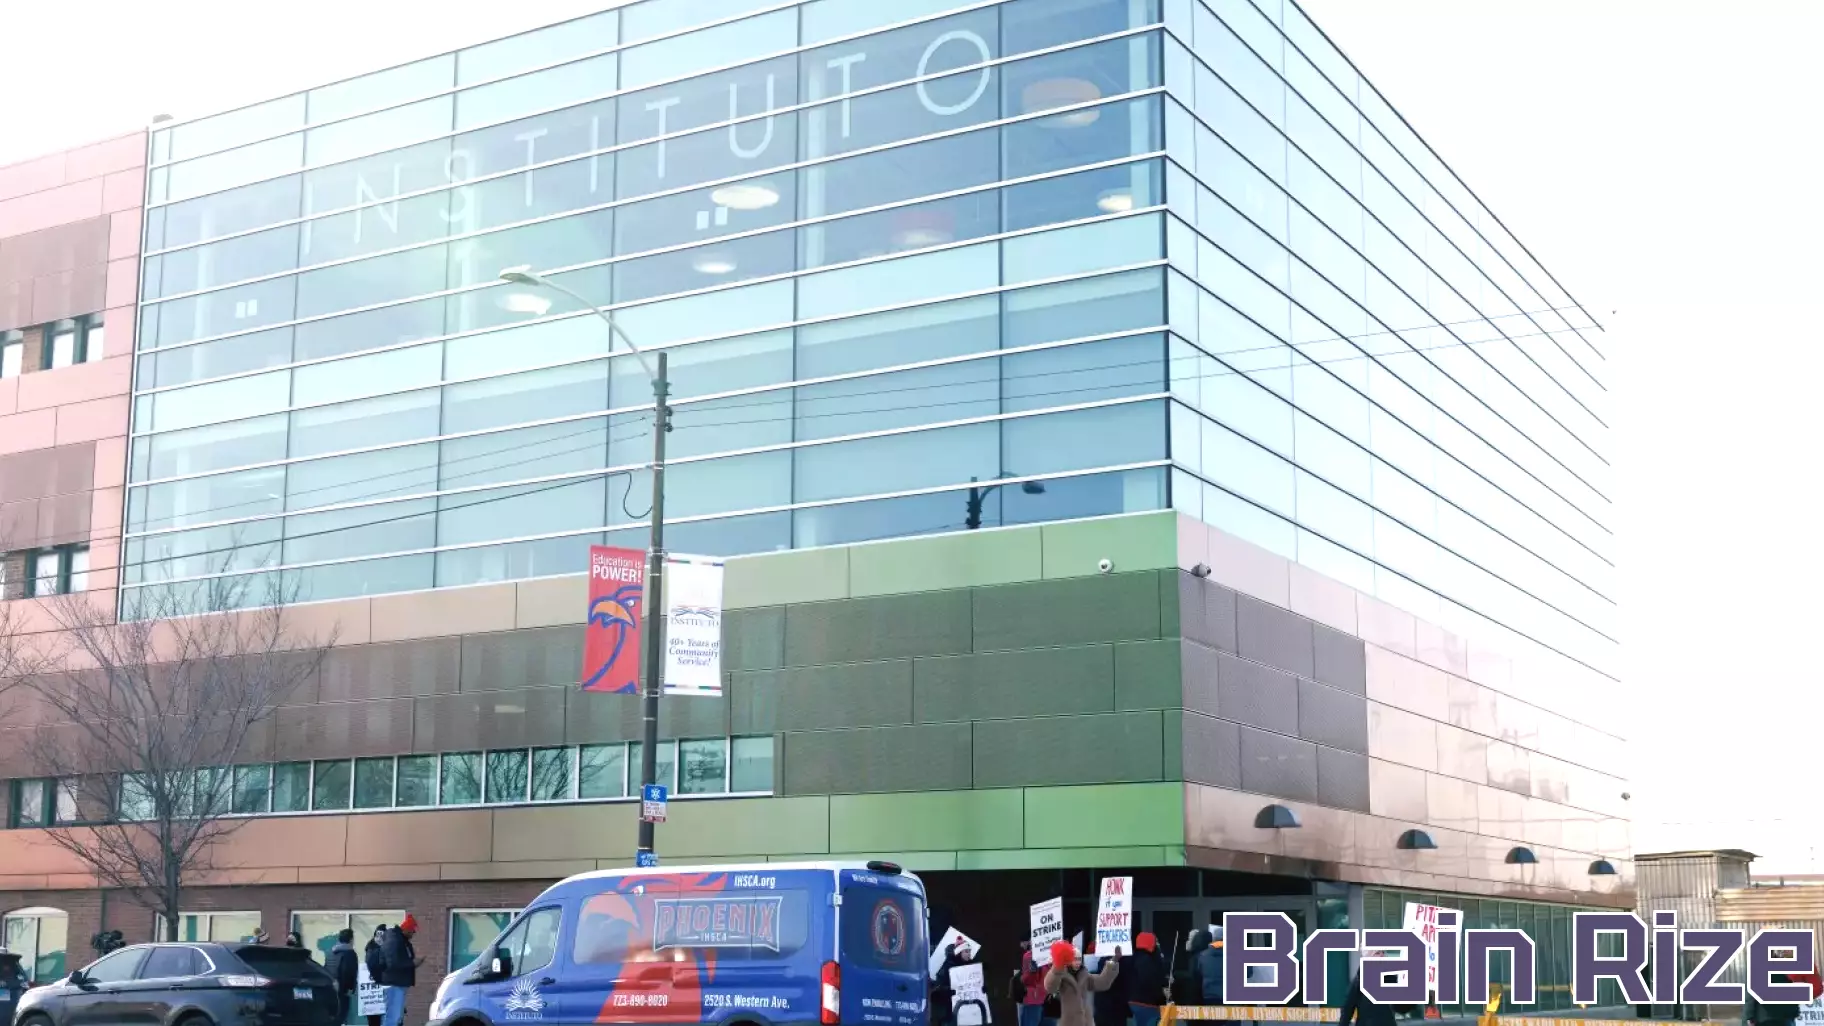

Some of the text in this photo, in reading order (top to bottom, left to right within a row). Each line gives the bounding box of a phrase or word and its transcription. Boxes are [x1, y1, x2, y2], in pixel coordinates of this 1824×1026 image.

[302, 29, 991, 257] INSTITUTO
[592, 554, 634, 567] Education
[592, 565, 642, 583] POWER!
[687, 638, 709, 647] Years
[669, 647, 719, 658] Community
[734, 874, 776, 889] IHSCA.org
[1105, 878, 1125, 896] HONK
[657, 902, 777, 943] PHOENIX
[1040, 913, 1054, 924] ON
[1099, 913, 1129, 928] SUPPORT
[1033, 921, 1062, 937] STRIKE
[700, 933, 727, 942] IHSCA
[704, 994, 724, 1007] 2520
[734, 995, 769, 1008] Western
[771, 996, 790, 1009] Ave.
